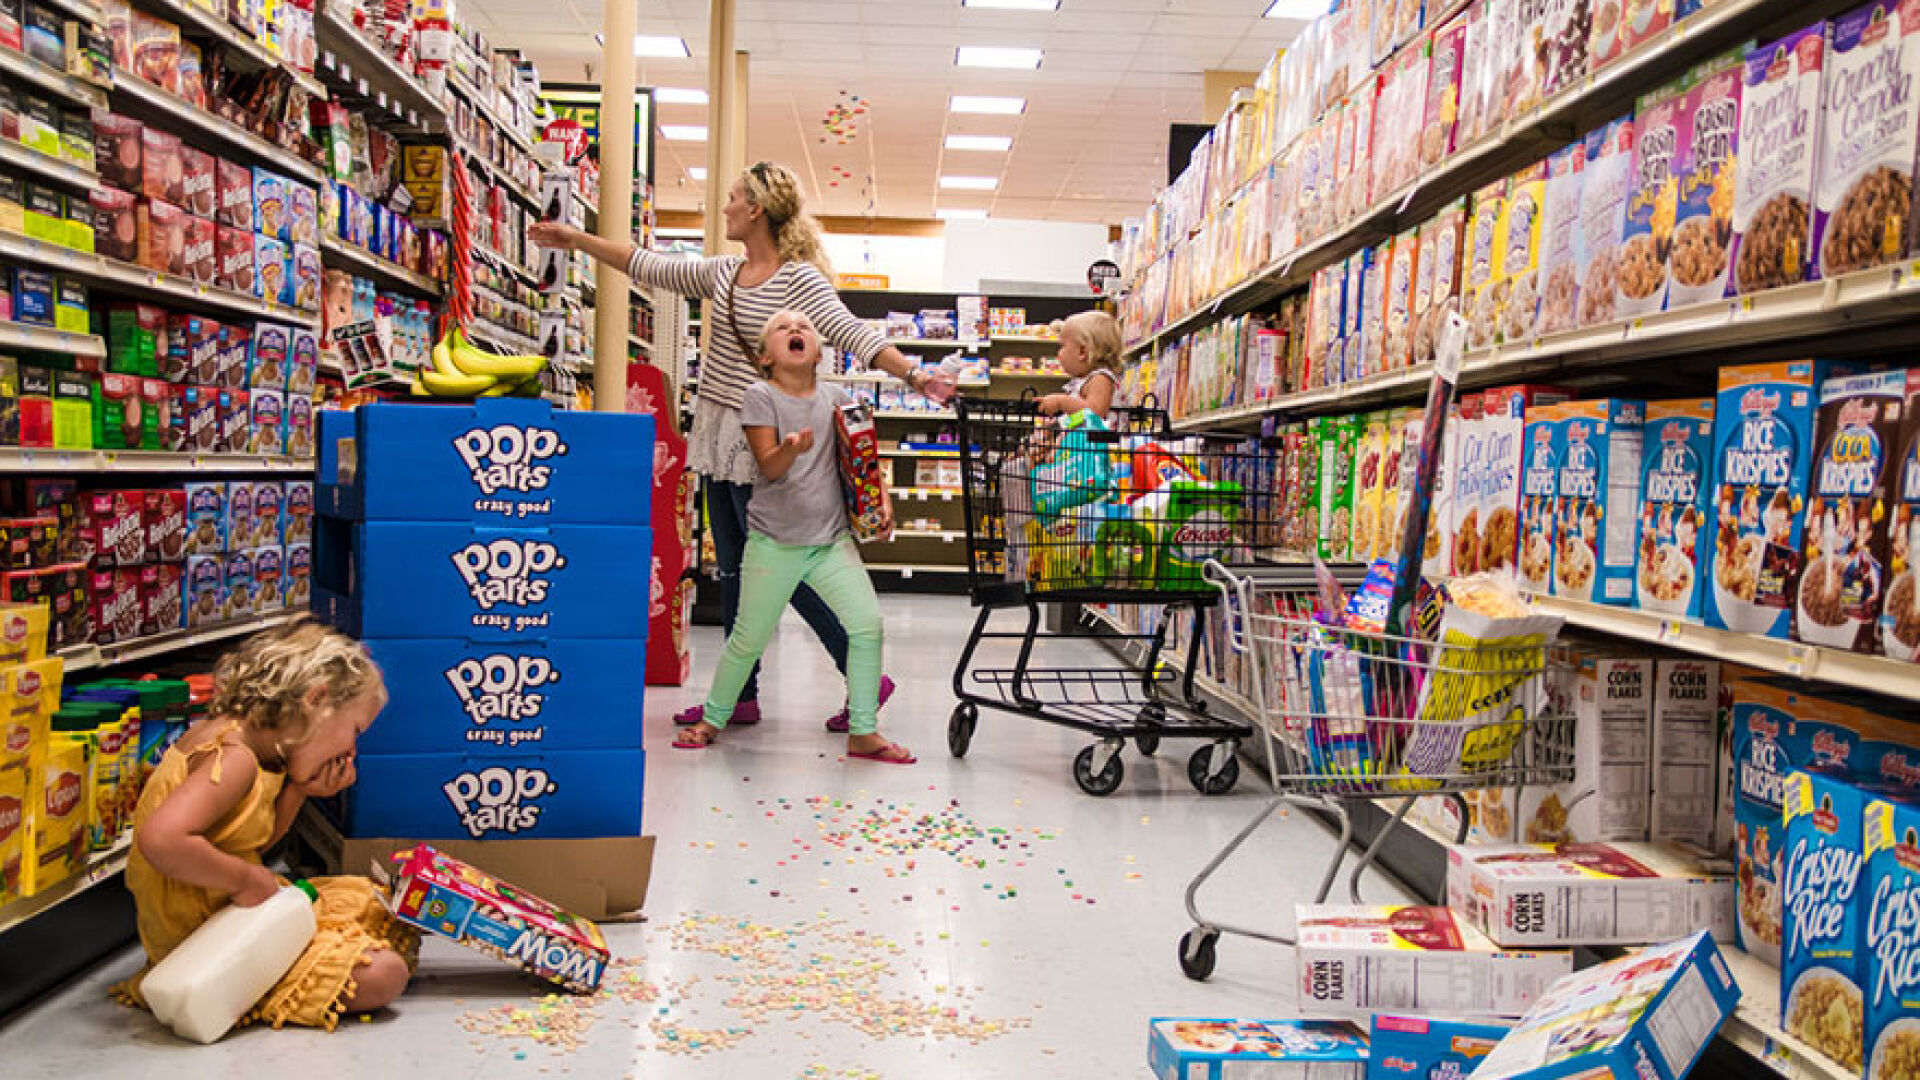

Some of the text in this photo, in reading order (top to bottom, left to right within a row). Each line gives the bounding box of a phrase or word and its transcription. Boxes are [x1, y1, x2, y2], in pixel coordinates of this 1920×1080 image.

[1743, 419, 1775, 451] RICE
[1726, 448, 1790, 484] KRISPIES
[474, 498, 551, 517] crazy good
[472, 612, 549, 631] crazy good
[1607, 671, 1642, 686] CORN
[1669, 671, 1707, 686] CORN
[466, 726, 542, 746] crazy good
[48, 783, 80, 809] Lipton
[1741, 758, 1784, 804] KRISPIE
[1784, 837, 1864, 907] Crispy
[1514, 893, 1530, 934] CORN
[1531, 892, 1545, 933] FLAKES
[1789, 886, 1844, 960] Rice
[1867, 874, 1920, 948] Cris
[505, 928, 599, 988] MOM
[1313, 960, 1329, 1000] CORN
[1330, 960, 1344, 1000] FLAKES
